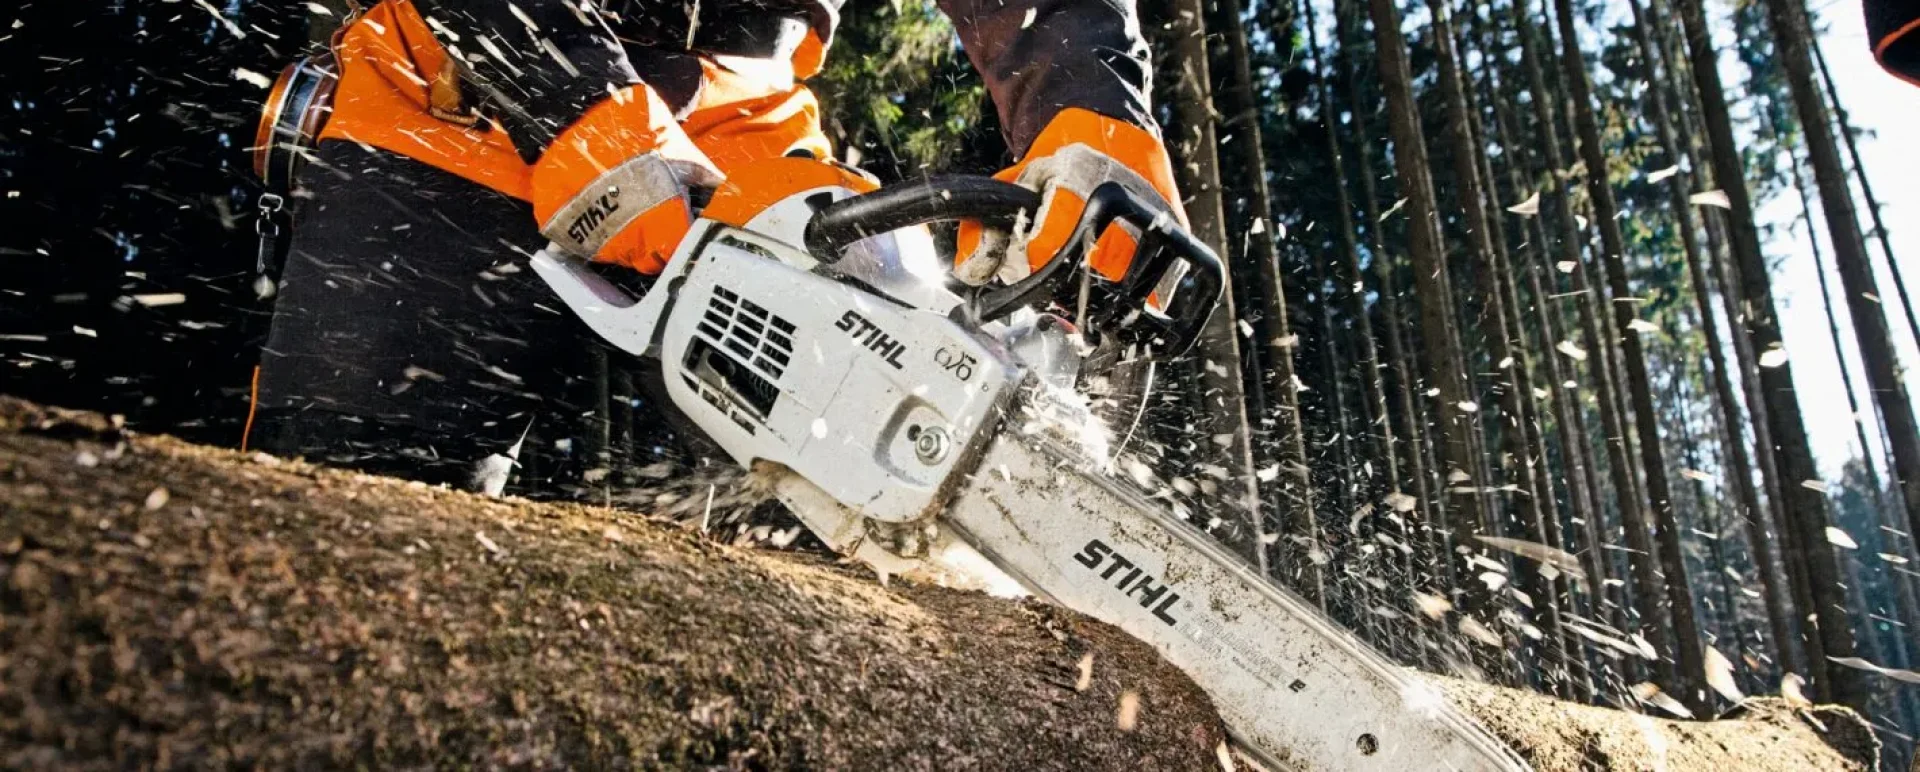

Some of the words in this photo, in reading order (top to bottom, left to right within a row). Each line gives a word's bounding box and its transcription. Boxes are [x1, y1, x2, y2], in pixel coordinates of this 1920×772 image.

[568, 194, 619, 244] STIHL
[834, 310, 906, 370] STIHL
[1073, 539, 1180, 626] STIHL
